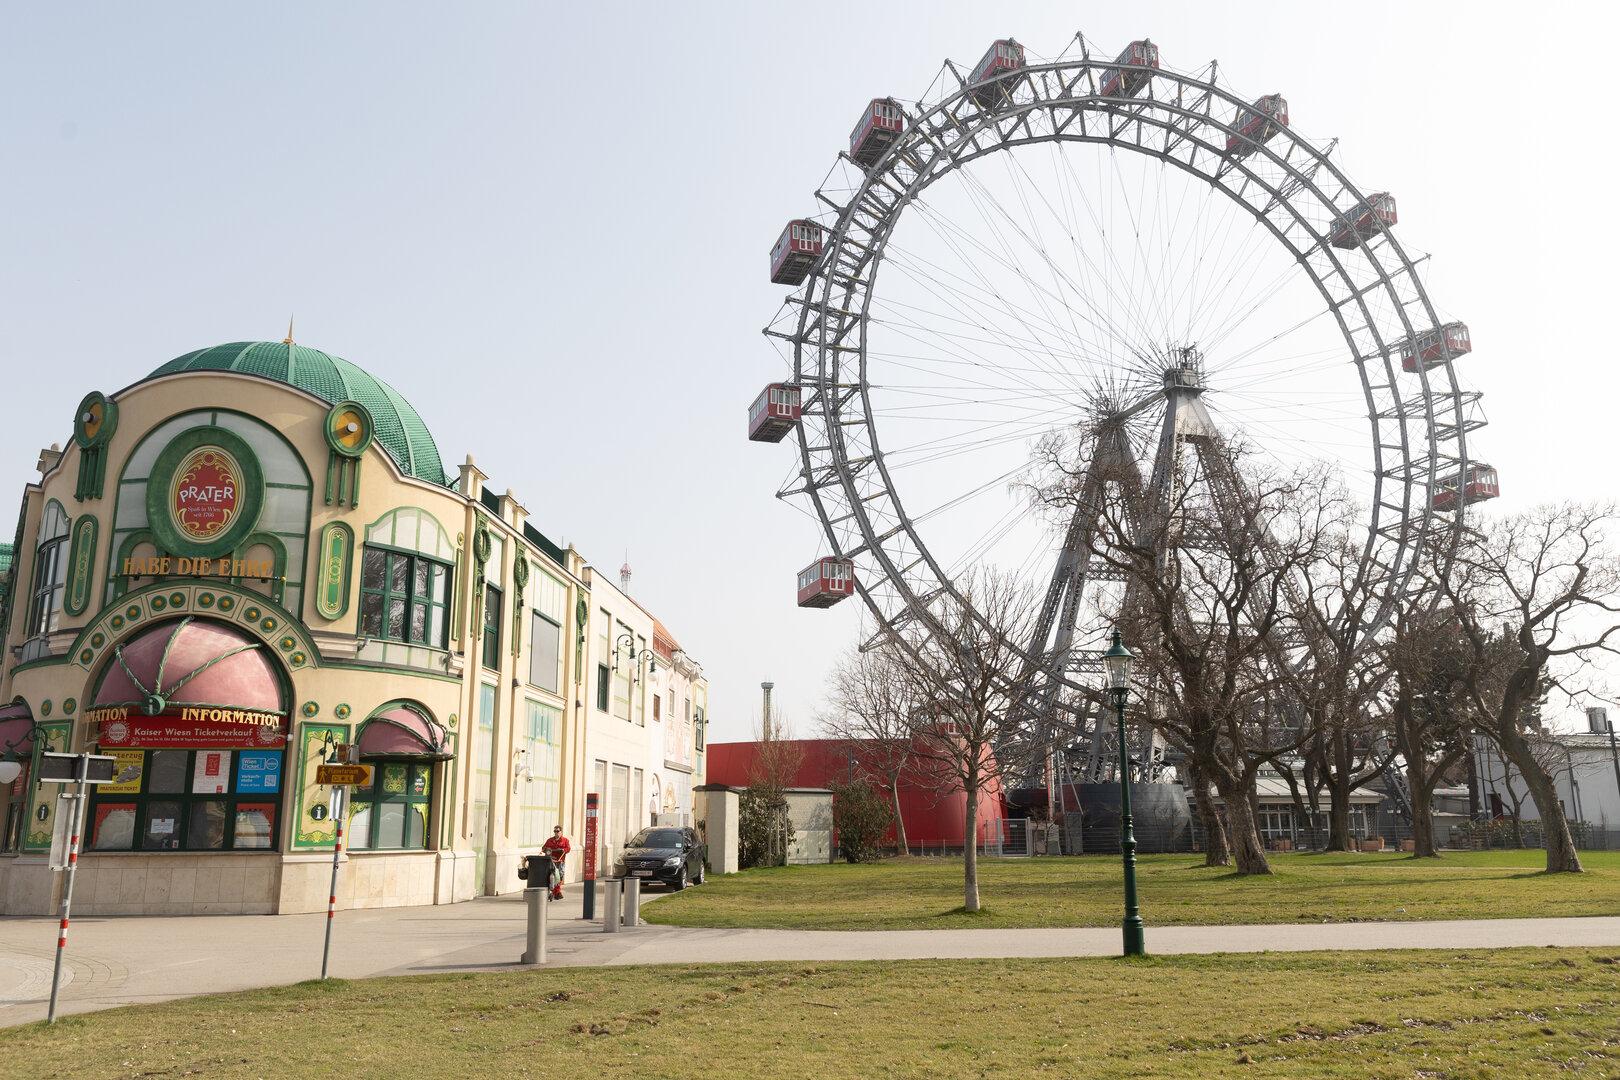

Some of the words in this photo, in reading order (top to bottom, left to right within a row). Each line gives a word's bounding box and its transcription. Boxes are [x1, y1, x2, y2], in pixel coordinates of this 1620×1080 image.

[179, 485, 234, 503] PRATER
[122, 557, 171, 575] HABE
[177, 557, 212, 576] DIE
[218, 558, 274, 578] EHRE
[181, 707, 280, 731] INFORMATION
[134, 727, 162, 736] Kaiser
[165, 727, 192, 736] Wiesn
[194, 727, 254, 736] Ticketverkauf
